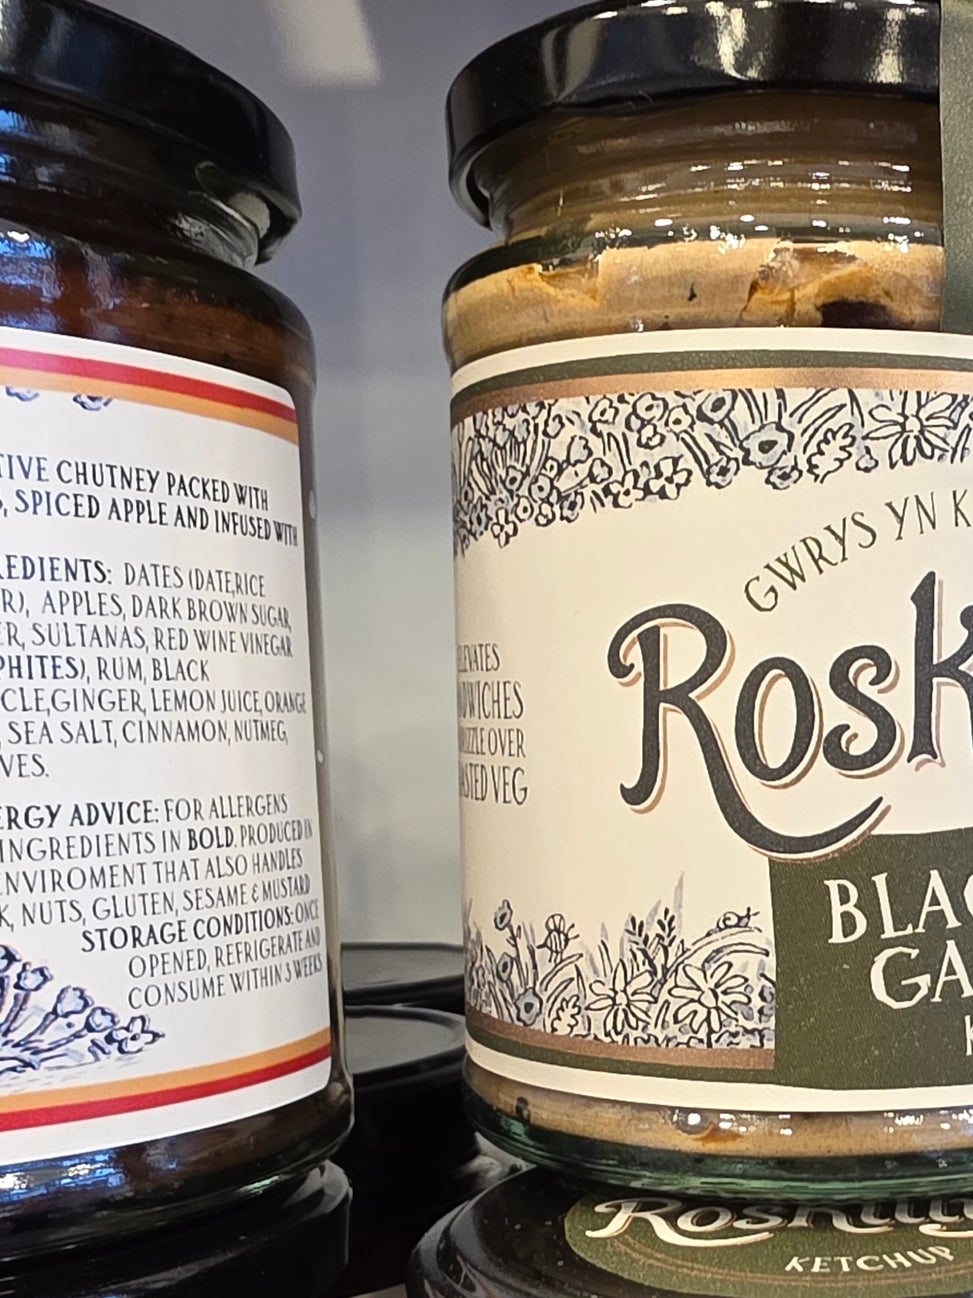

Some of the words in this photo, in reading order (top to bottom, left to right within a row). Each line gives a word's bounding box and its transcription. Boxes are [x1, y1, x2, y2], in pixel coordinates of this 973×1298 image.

[56, 459, 160, 494] CHUTNEY
[167, 472, 230, 504] PACKED
[234, 482, 269, 512] WITH
[14, 488, 100, 519] SPICED
[108, 498, 168, 526] APPLE
[174, 505, 209, 531] AND
[214, 510, 272, 541] INFUSED
[274, 520, 298, 547] WITH
[0, 555, 112, 585] EDIENTS:
[124, 562, 183, 589] DATES
[744, 511, 878, 613] GWRYS
[886, 497, 938, 541] YN
[41, 589, 126, 621] APPLES,
[131, 594, 182, 620] DARK
[187, 598, 248, 624] BROWN
[251, 604, 292, 633] SUGAR,
[31, 622, 149, 654] SULTANAS,
[154, 627, 189, 651] RED
[193, 628, 237, 654] WINE
[240, 633, 293, 658] VINEGAR
[97, 656, 147, 685] RUM,
[152, 657, 210, 682] BLACK
[151, 687, 216, 712] LEMON
[220, 689, 263, 716] JUICE,
[264, 691, 307, 714] ORANGE
[7, 720, 53, 744] SEA
[60, 719, 118, 748] SALT,
[122, 719, 231, 747] CINNAMON,
[234, 719, 289, 746] NUTMEG,
[487, 728, 525, 758] OVER
[491, 764, 528, 806] VEG
[69, 799, 159, 827] ADVICE:
[164, 798, 205, 822] FOR
[209, 793, 288, 820] ALLERGENS
[162, 829, 181, 852] IN
[188, 826, 237, 851] BOLD.
[240, 819, 302, 848] PRODUCED
[304, 818, 313, 840] IN
[0, 862, 147, 896] NVIROMENT
[153, 858, 202, 884] THAT
[205, 854, 247, 881] ALSO
[252, 848, 303, 875] HANDLES
[22, 899, 86, 928] NUTS,
[92, 889, 179, 921] GLUTEN,
[183, 883, 247, 912] SESAME
[252, 883, 259, 903] &
[262, 873, 311, 902] MUSTARD
[81, 919, 188, 952] STORAGE
[193, 906, 294, 941] CONDITIONS:
[295, 898, 319, 923] ONCE
[128, 943, 211, 978] OPENED,
[215, 930, 303, 968] REFRIGERATE
[304, 926, 321, 948] AND
[128, 977, 226, 1010] CONSUME
[229, 965, 282, 994] WITHIN
[294, 953, 323, 980] WEEKS
[784, 1245, 955, 1274] KETCHUP
